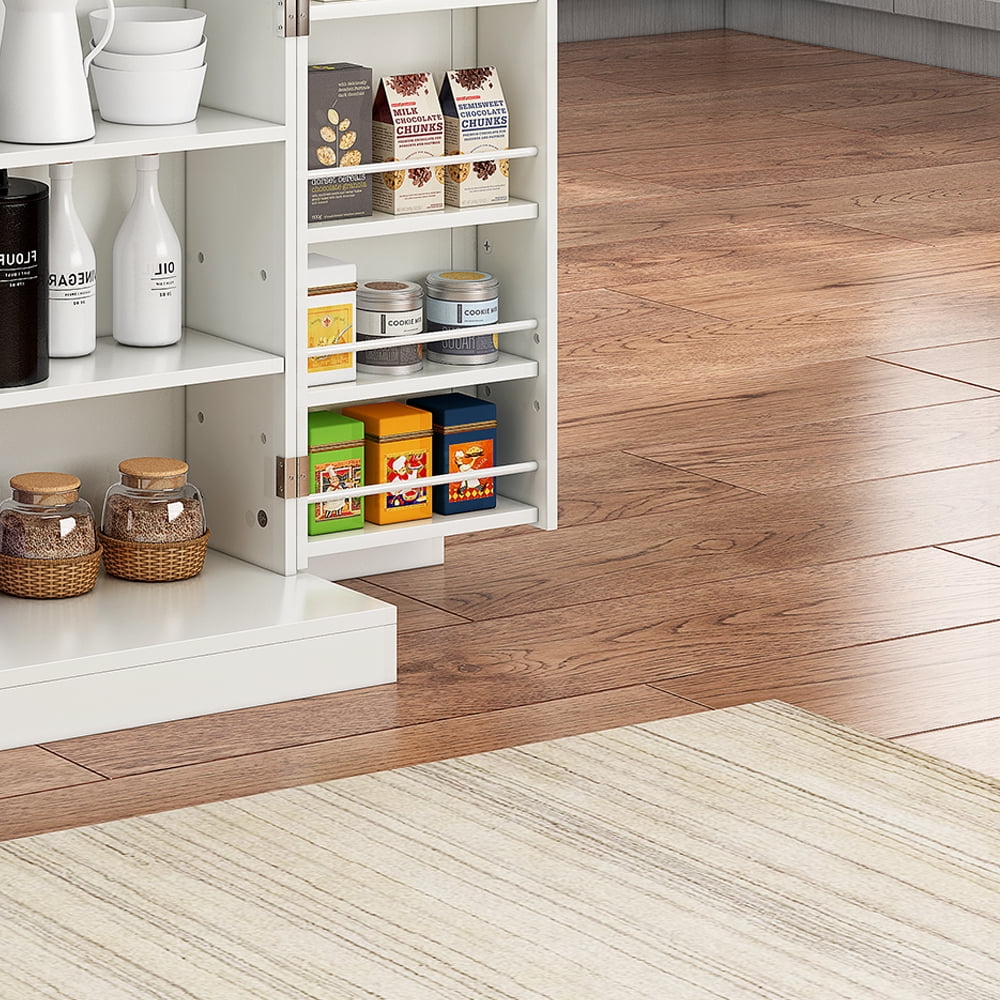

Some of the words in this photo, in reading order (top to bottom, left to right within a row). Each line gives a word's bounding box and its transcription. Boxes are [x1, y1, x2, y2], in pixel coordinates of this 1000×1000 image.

[458, 100, 504, 110] SEMISWEET
[393, 107, 418, 117] MILK
[460, 108, 506, 118] CHOCOLATE
[395, 114, 443, 125] CHOCOLATE
[461, 116, 507, 128] CHUNKS
[396, 122, 443, 135] CHUNKS
[463, 308, 490, 316] COOKIE
[387, 318, 414, 327] COOKIE
